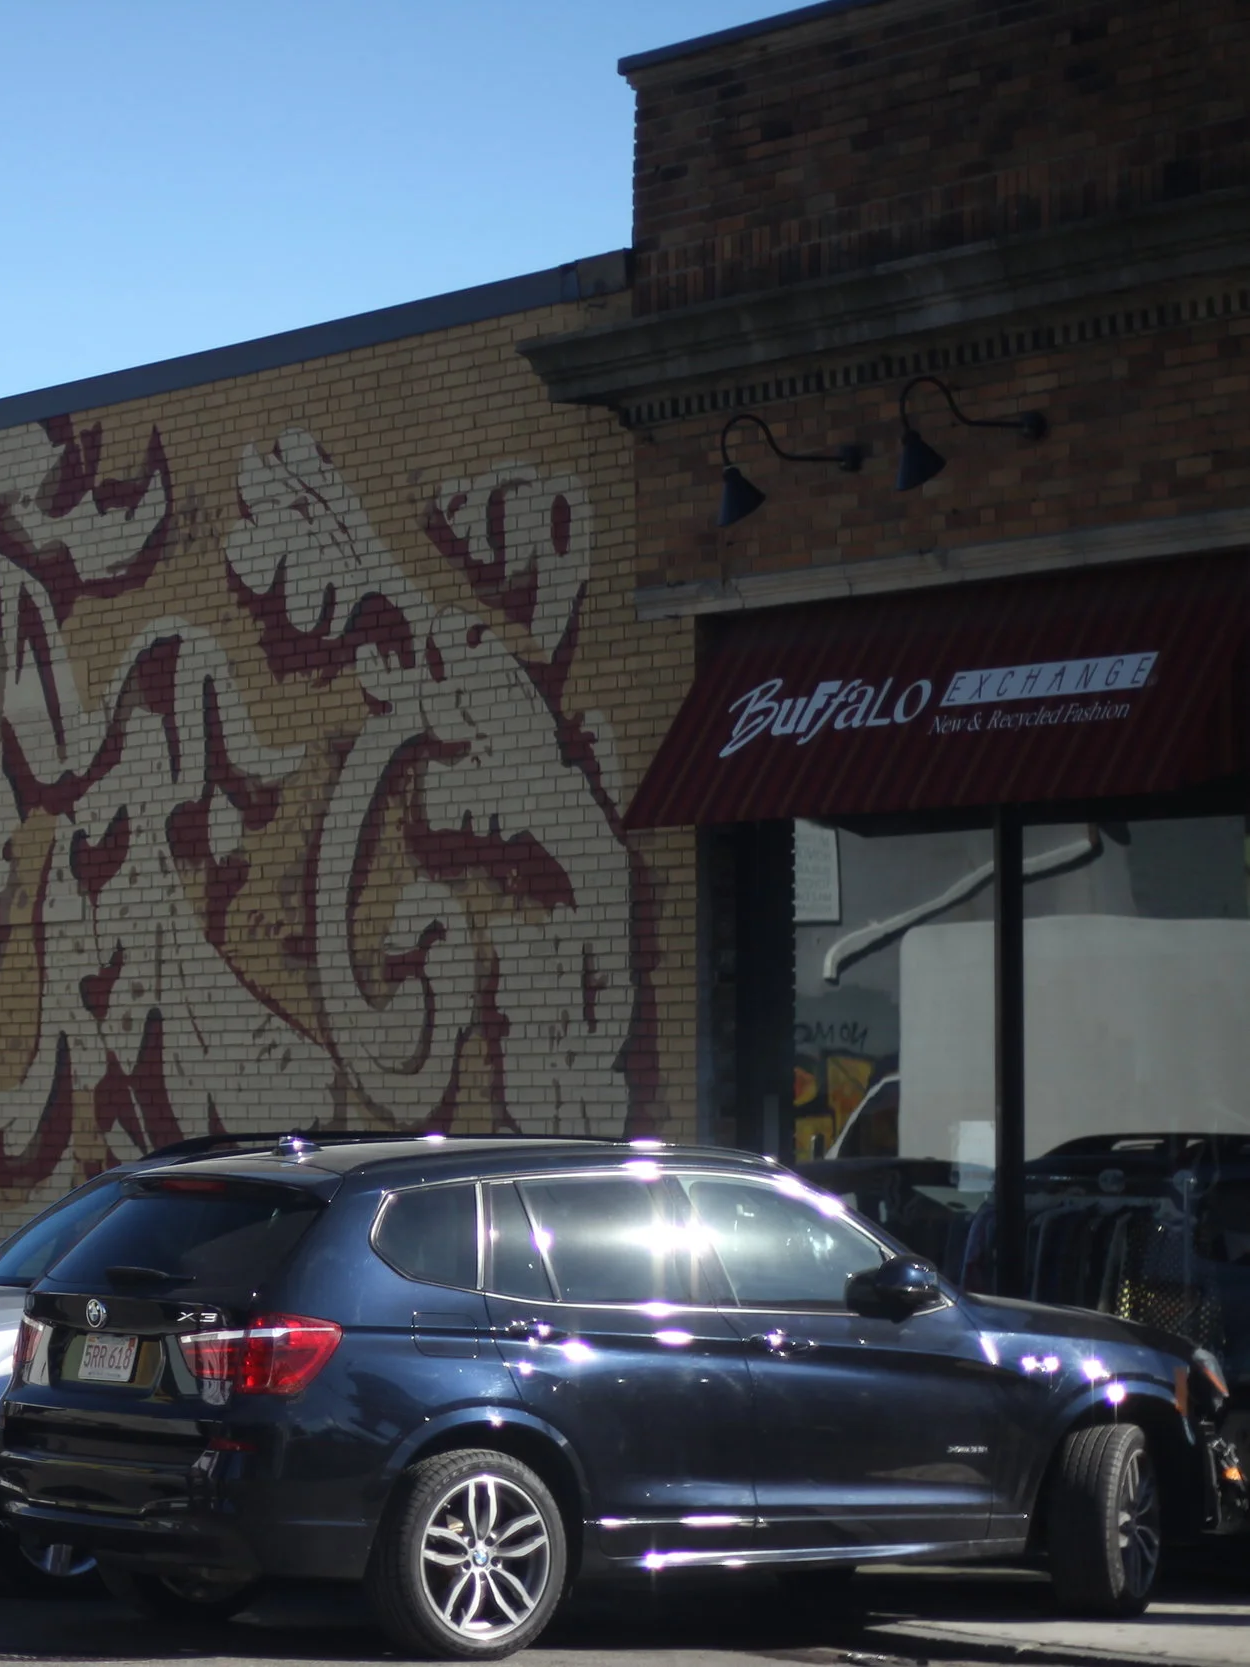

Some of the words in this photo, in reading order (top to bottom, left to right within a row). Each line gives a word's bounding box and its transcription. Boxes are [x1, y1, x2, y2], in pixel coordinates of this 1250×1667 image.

[946, 656, 1152, 703] EXCHANGE
[927, 714, 966, 735] New
[968, 711, 983, 731] &
[987, 706, 1062, 731] Recycled
[1063, 700, 1131, 723] Fashion
[176, 1311, 219, 1323] X3
[83, 1344, 108, 1368] 5RR
[107, 1346, 133, 1370] 618
